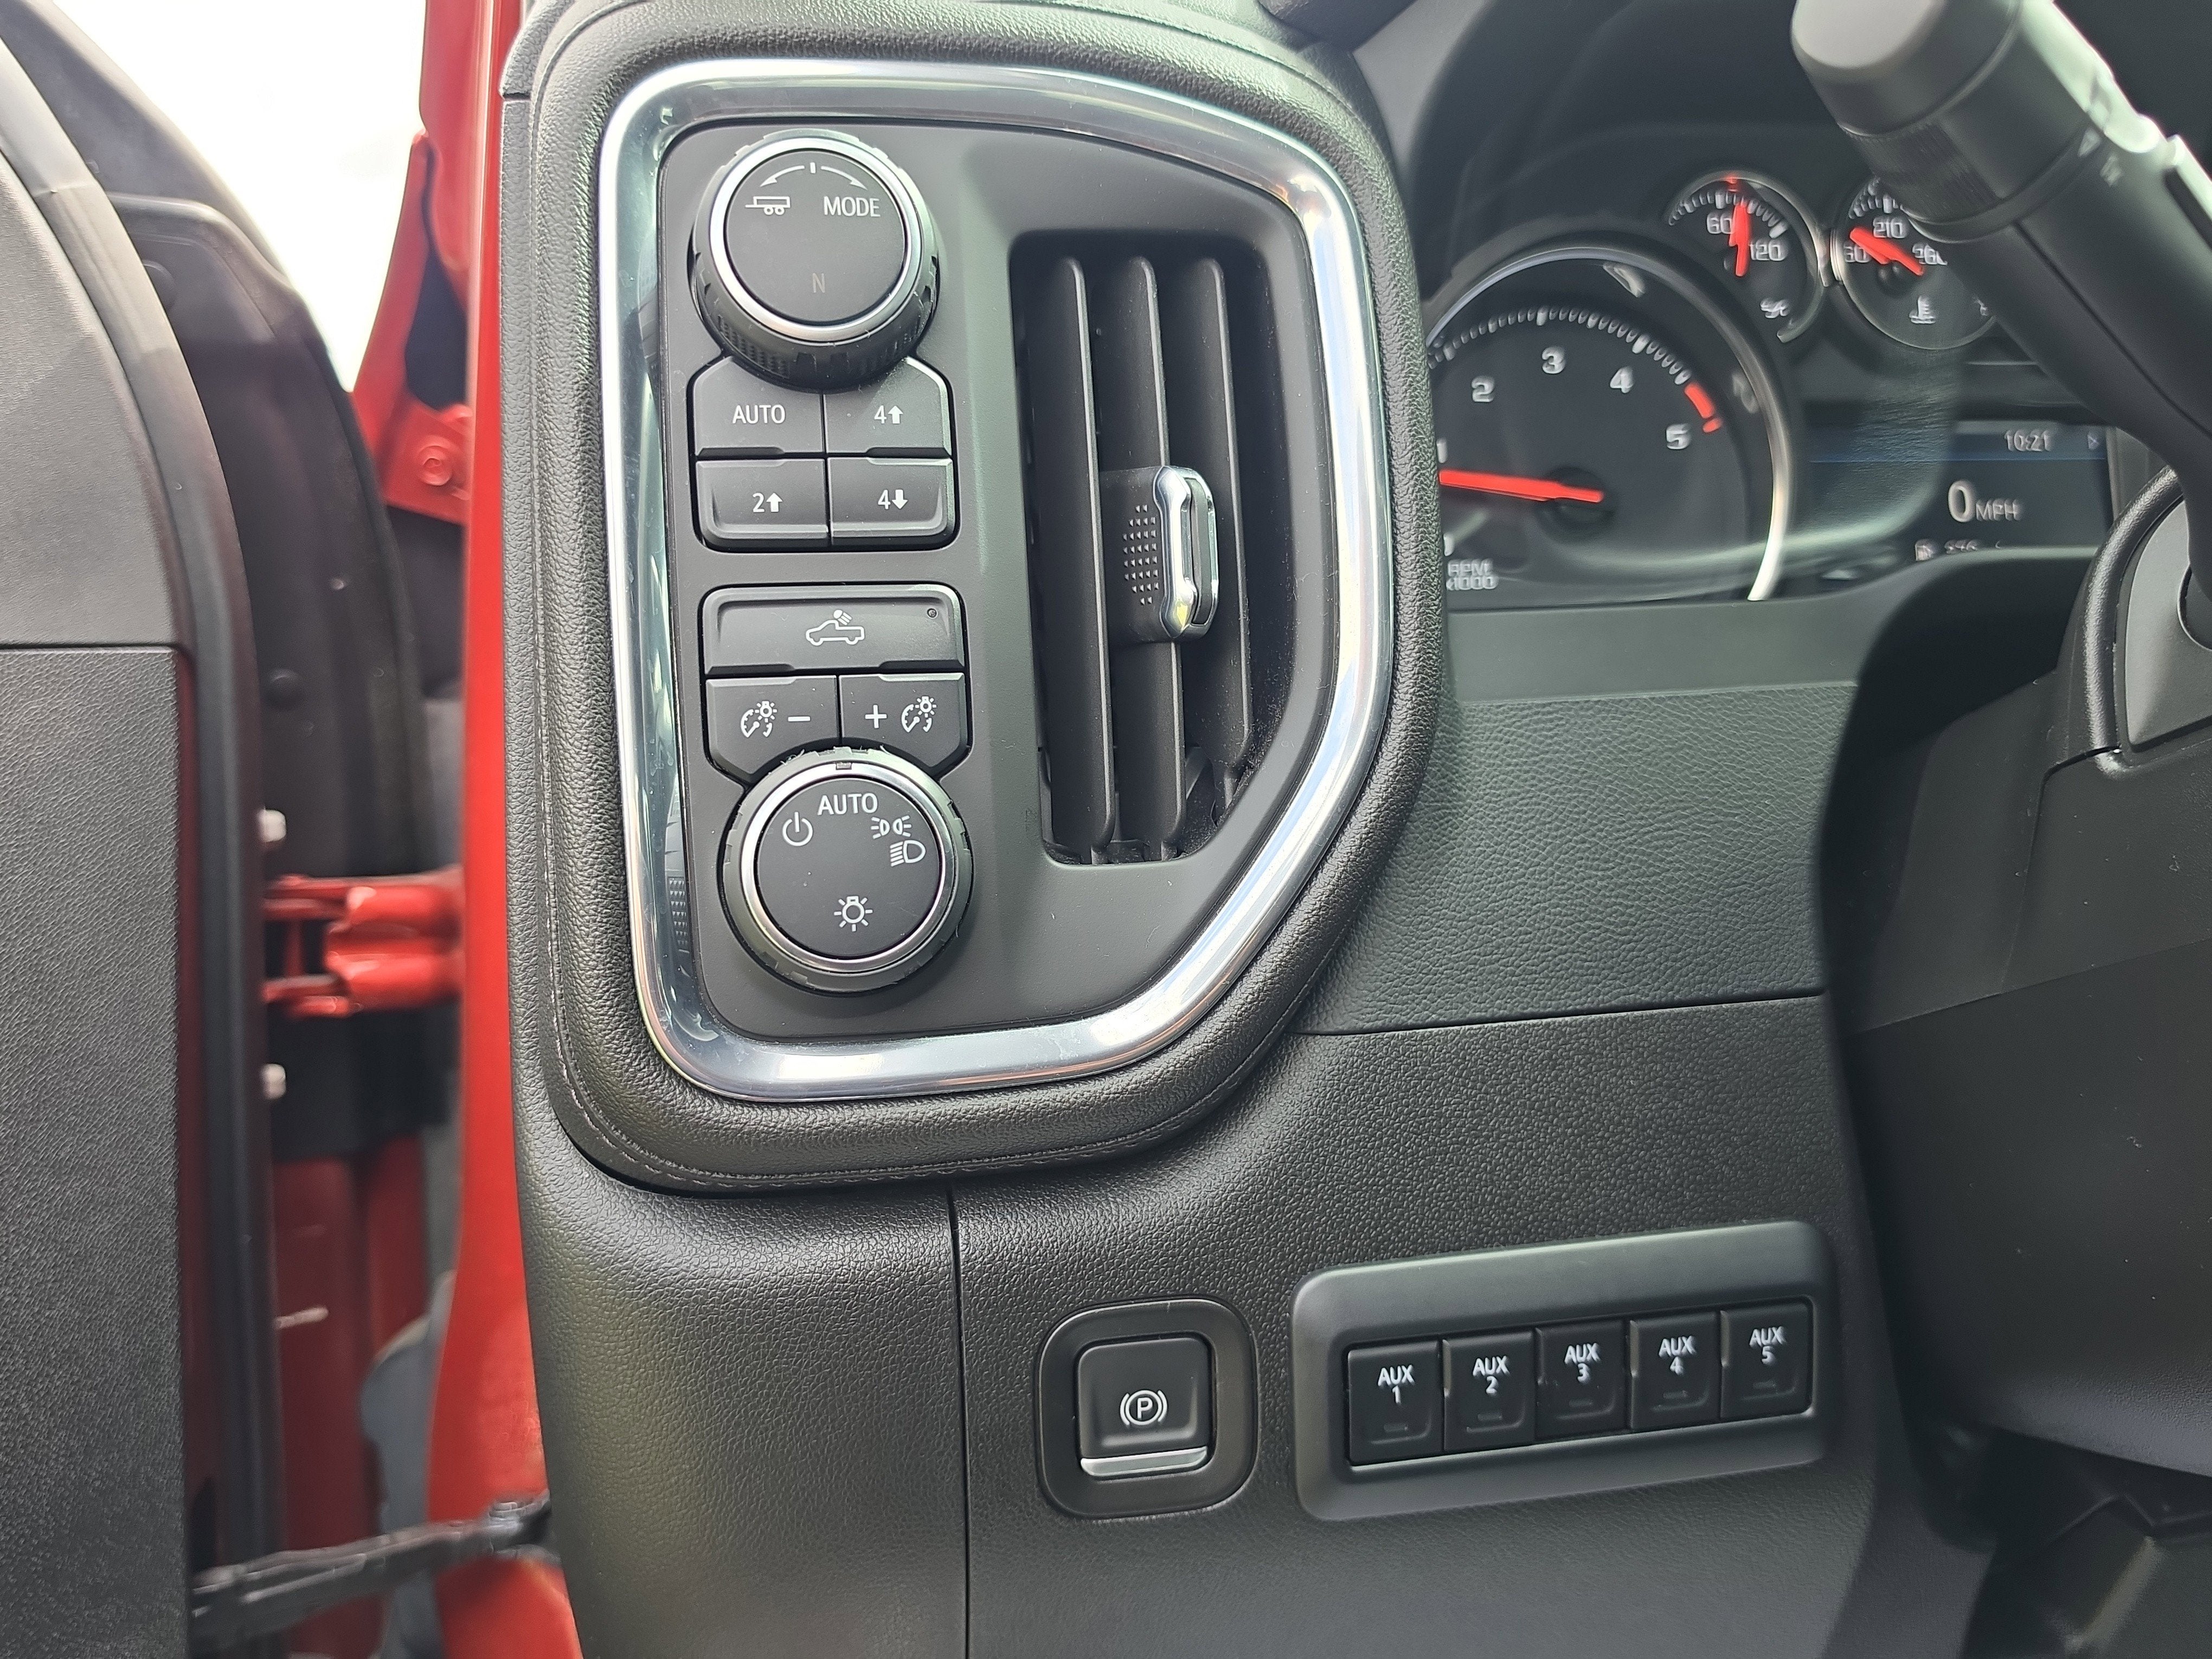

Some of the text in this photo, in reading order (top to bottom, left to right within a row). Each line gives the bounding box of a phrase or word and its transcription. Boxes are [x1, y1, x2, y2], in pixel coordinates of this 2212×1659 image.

[824, 196, 881, 217] MODE
[1873, 218, 1907, 239] 210
[1749, 240, 1788, 261] 120
[812, 272, 826, 293] N
[1541, 346, 1566, 374] 3
[1471, 376, 1495, 402] 2
[1610, 366, 1634, 394] 4
[732, 404, 786, 424] AUTO
[1666, 423, 1691, 449] 5
[2005, 429, 2051, 452] 10:21
[1947, 480, 2022, 523] 0 MPH
[817, 793, 878, 816] AUTO
[1658, 1335, 1696, 1357] AUX
[1749, 1326, 1785, 1346] AUX
[1564, 1342, 1601, 1363] AUX
[1761, 1346, 1773, 1365] 5
[1378, 1365, 1415, 1386] AUX
[1472, 1355, 1510, 1376] AUX
[1577, 1362, 1590, 1382] 3
[1669, 1356, 1684, 1374] 4
[1392, 1386, 1402, 1404] 1
[1486, 1375, 1498, 1395] 2
